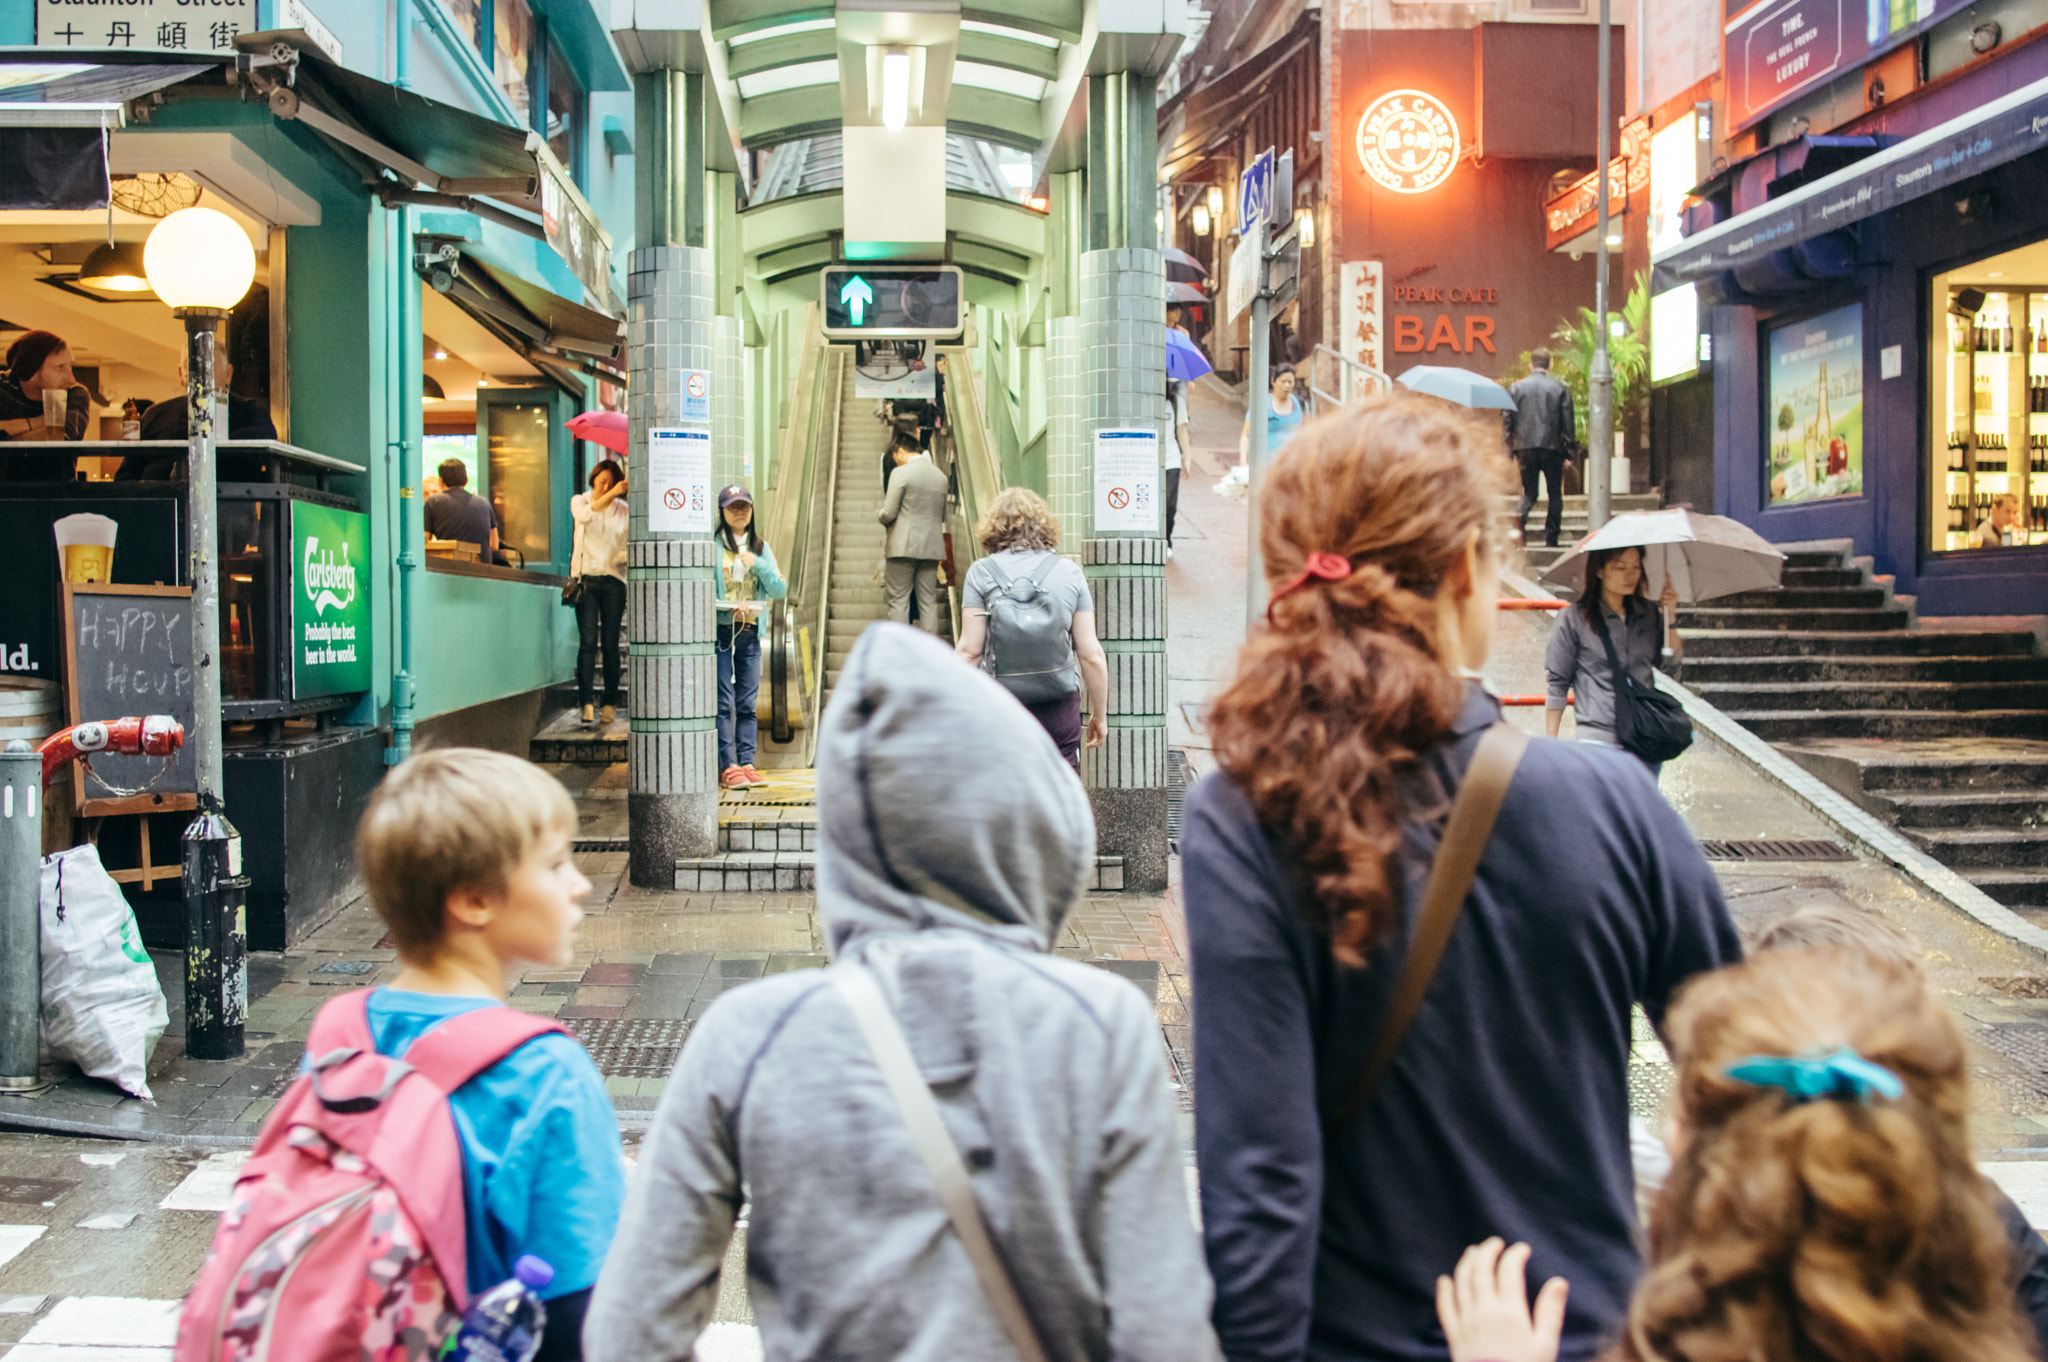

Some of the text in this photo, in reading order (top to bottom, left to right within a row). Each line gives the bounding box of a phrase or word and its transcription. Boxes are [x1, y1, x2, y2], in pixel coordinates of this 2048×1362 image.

[1776, 51, 1809, 84] LUXURY
[1394, 286, 1499, 304] PEAK CAFE
[1393, 314, 1497, 354] BAR
[304, 536, 355, 602] Carlsberg
[305, 621, 356, 645] Probably the best
[305, 644, 358, 665] beer in the world.
